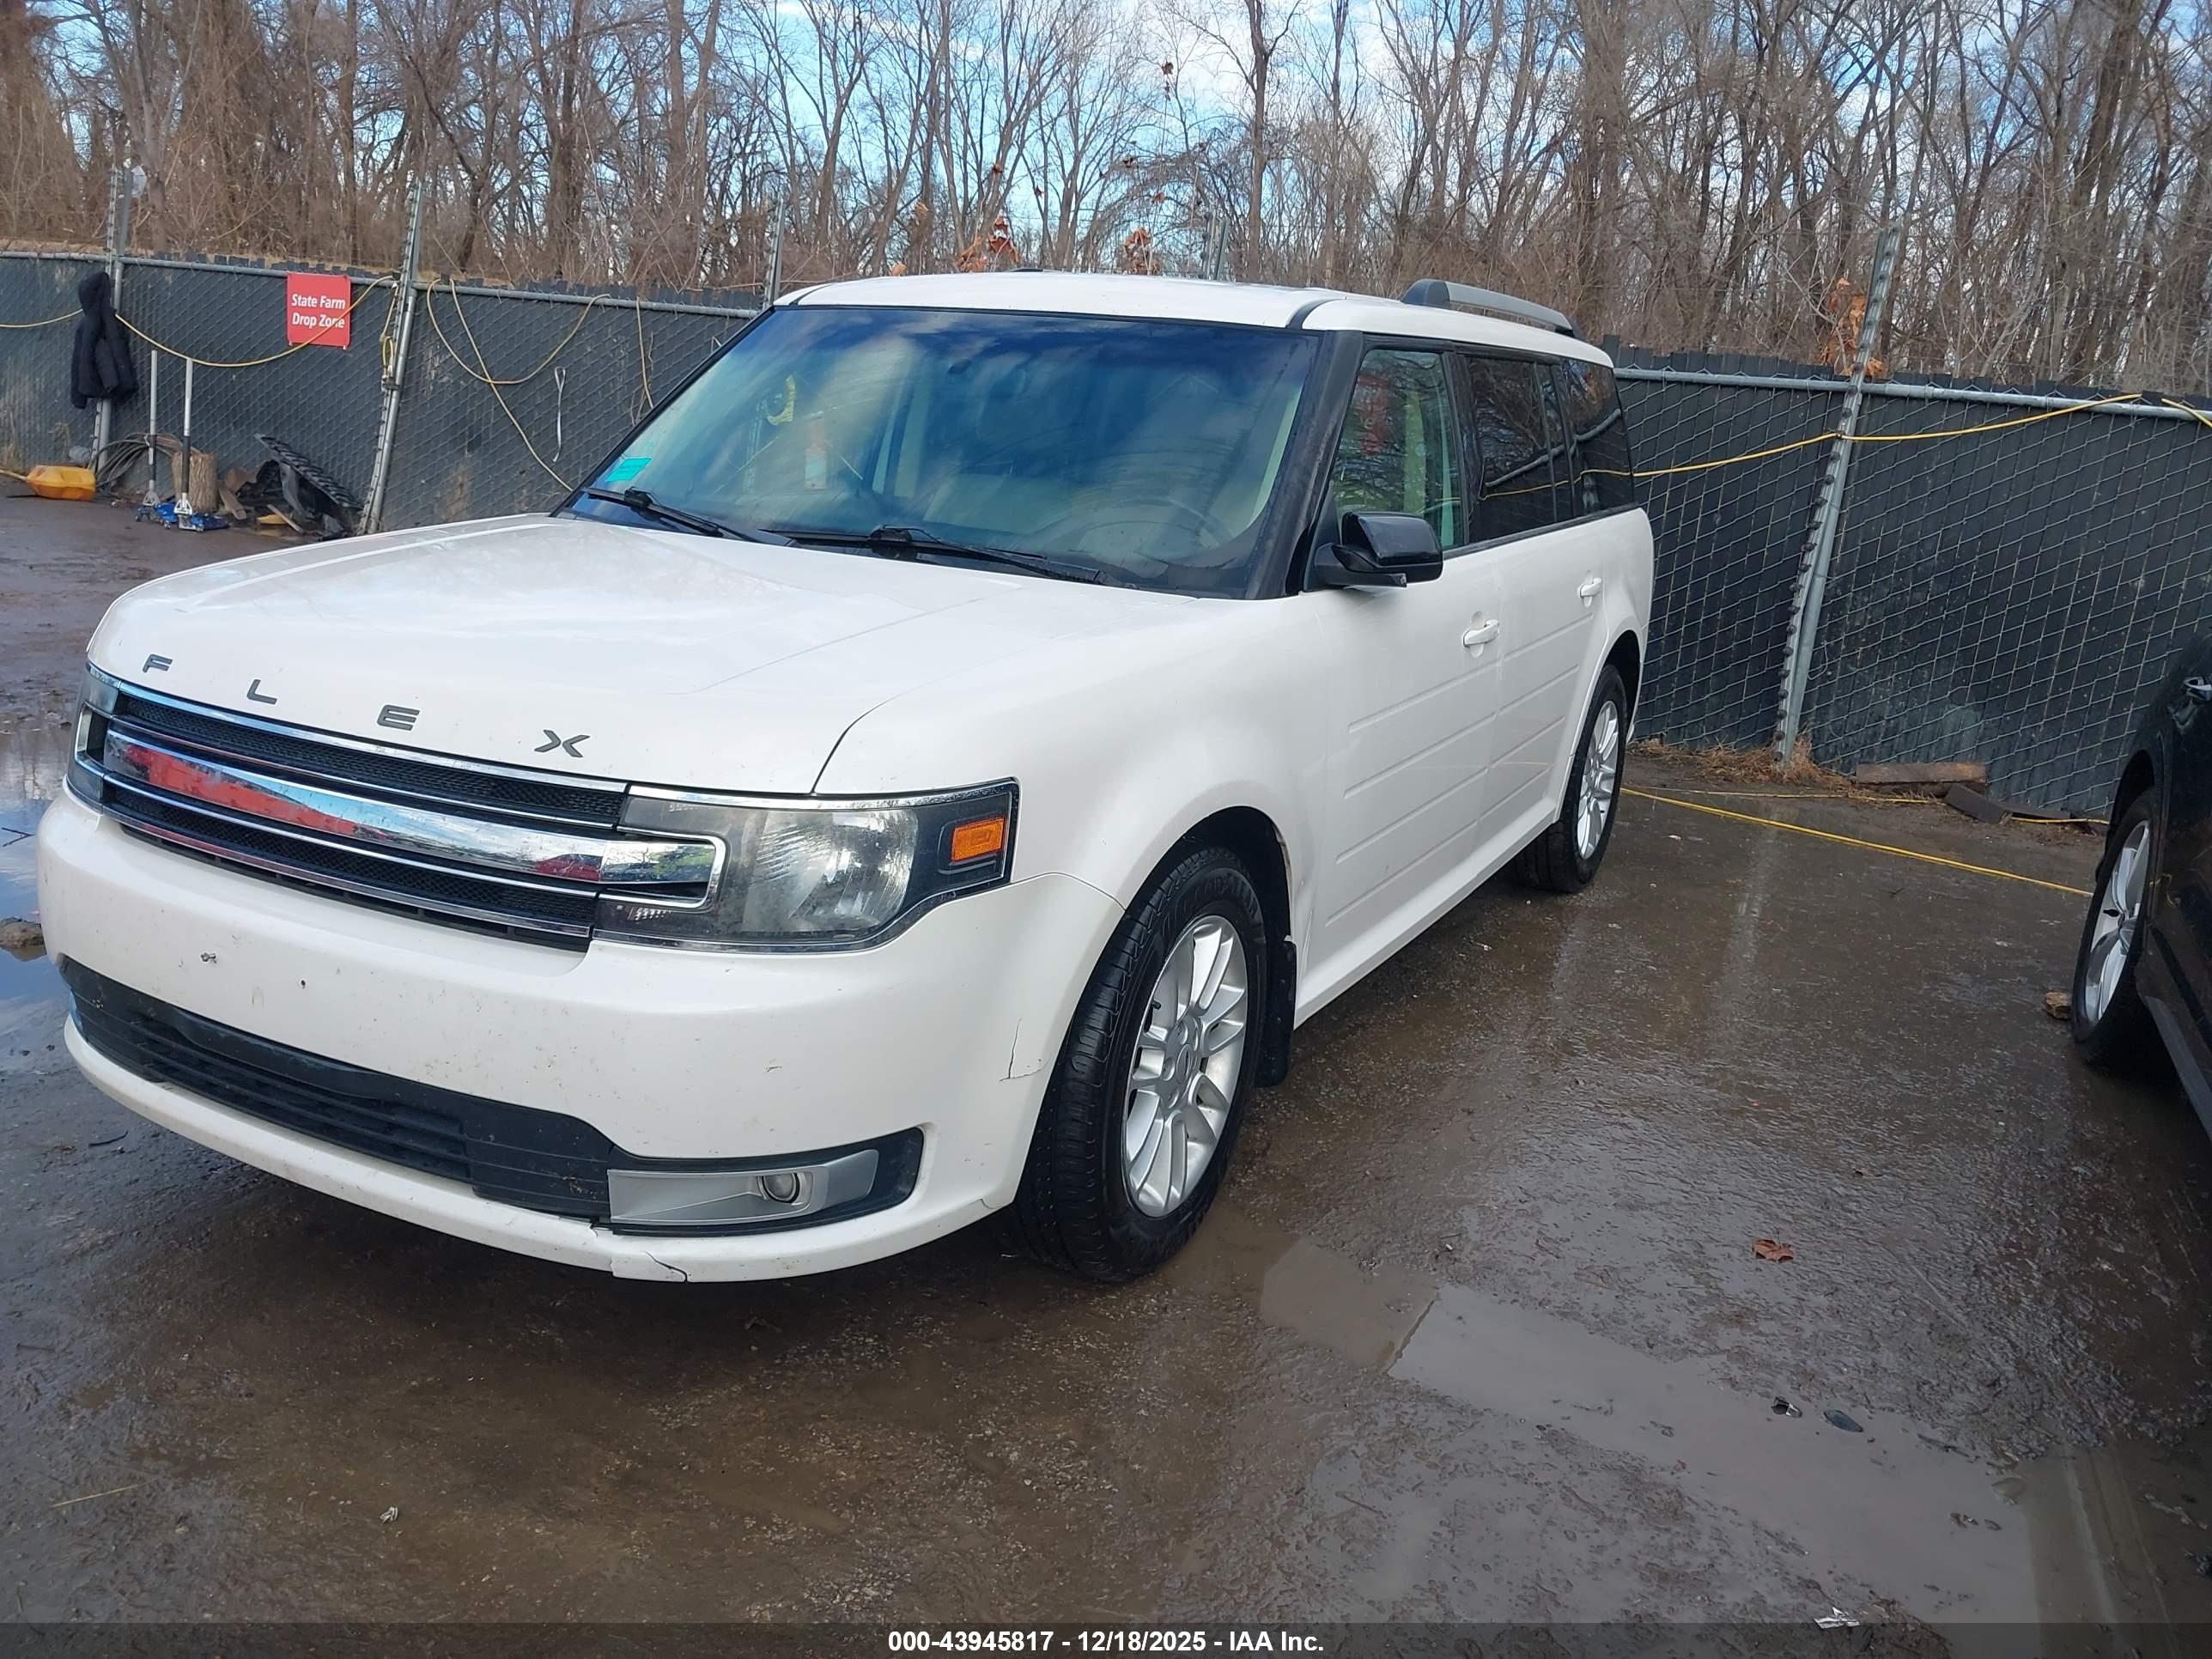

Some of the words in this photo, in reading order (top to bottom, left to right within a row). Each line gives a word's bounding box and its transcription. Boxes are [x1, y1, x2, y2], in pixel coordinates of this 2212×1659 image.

[292, 294, 317, 307] State
[319, 295, 345, 309] Farm
[292, 312, 317, 329] Drop
[319, 314, 345, 328] Zone
[142, 653, 591, 758] FLEX
